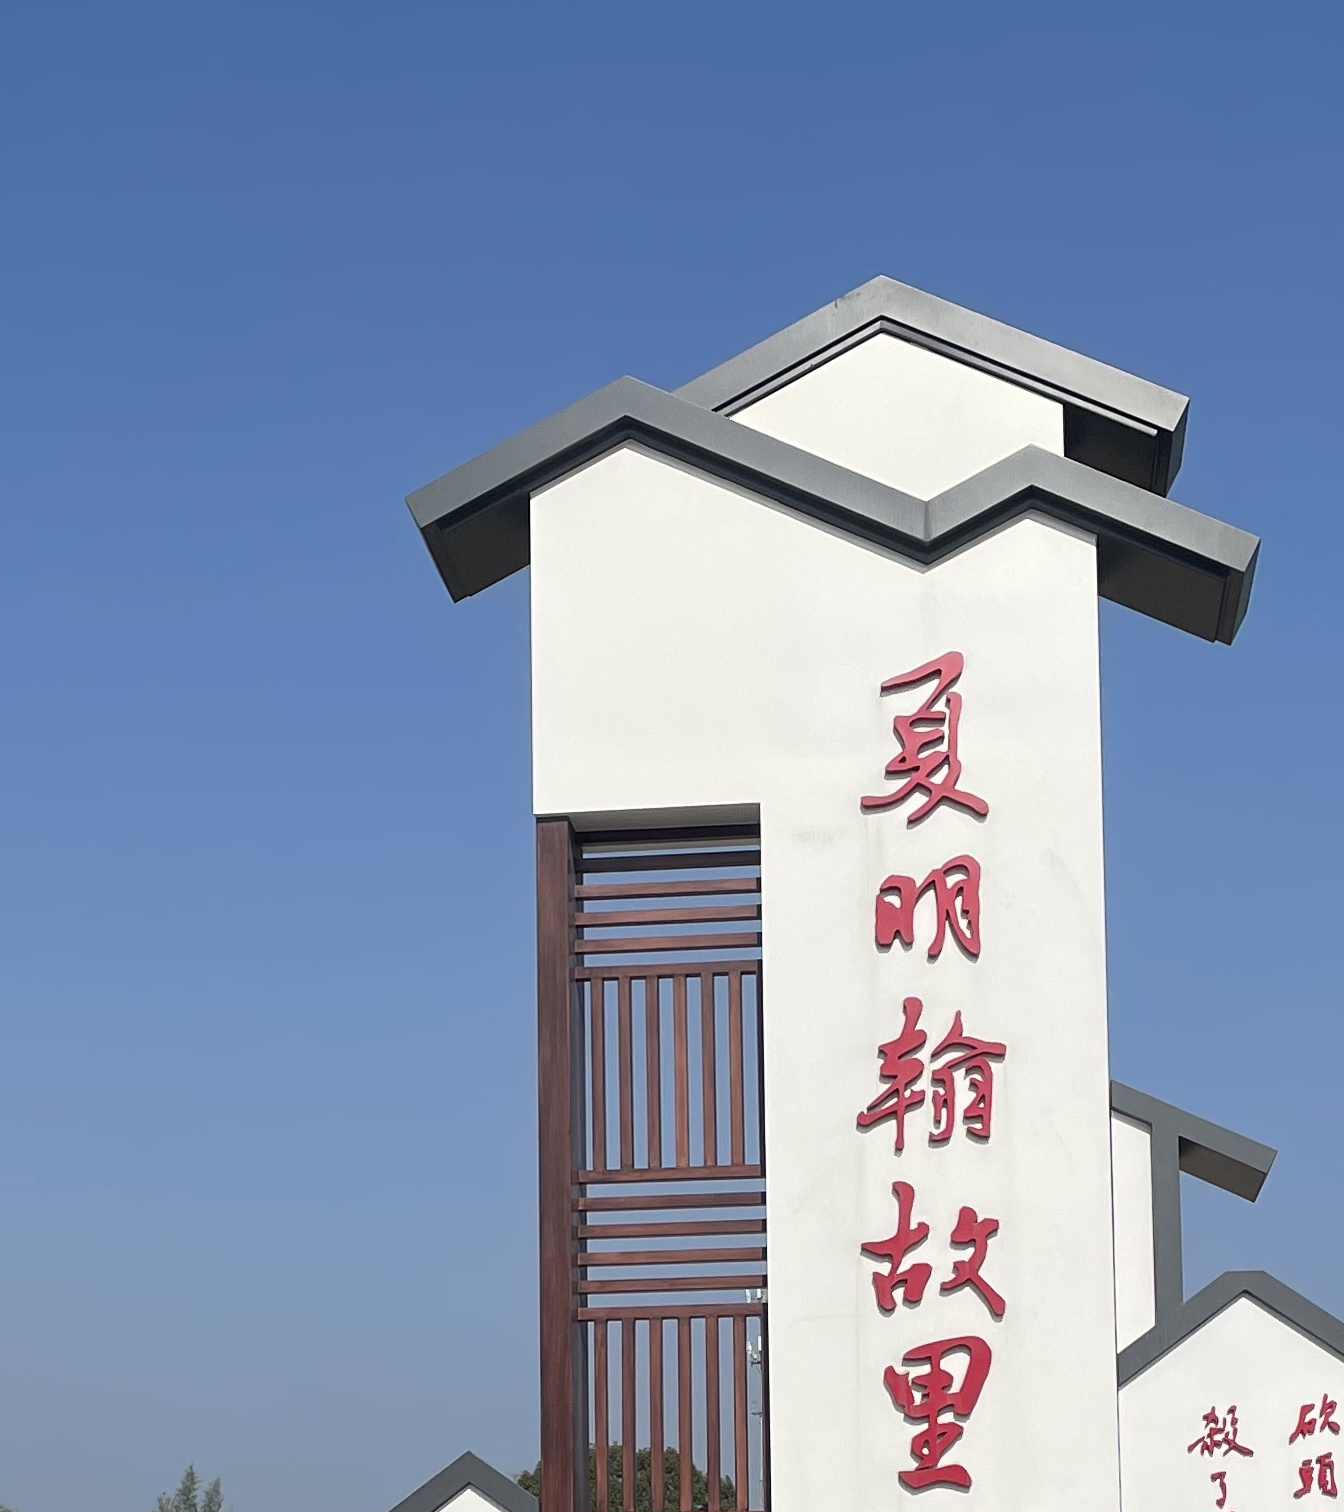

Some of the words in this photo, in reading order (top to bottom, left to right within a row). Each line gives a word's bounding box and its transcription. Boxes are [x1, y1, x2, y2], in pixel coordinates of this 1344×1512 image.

[856, 650, 1007, 1492] 夏明翰故里
